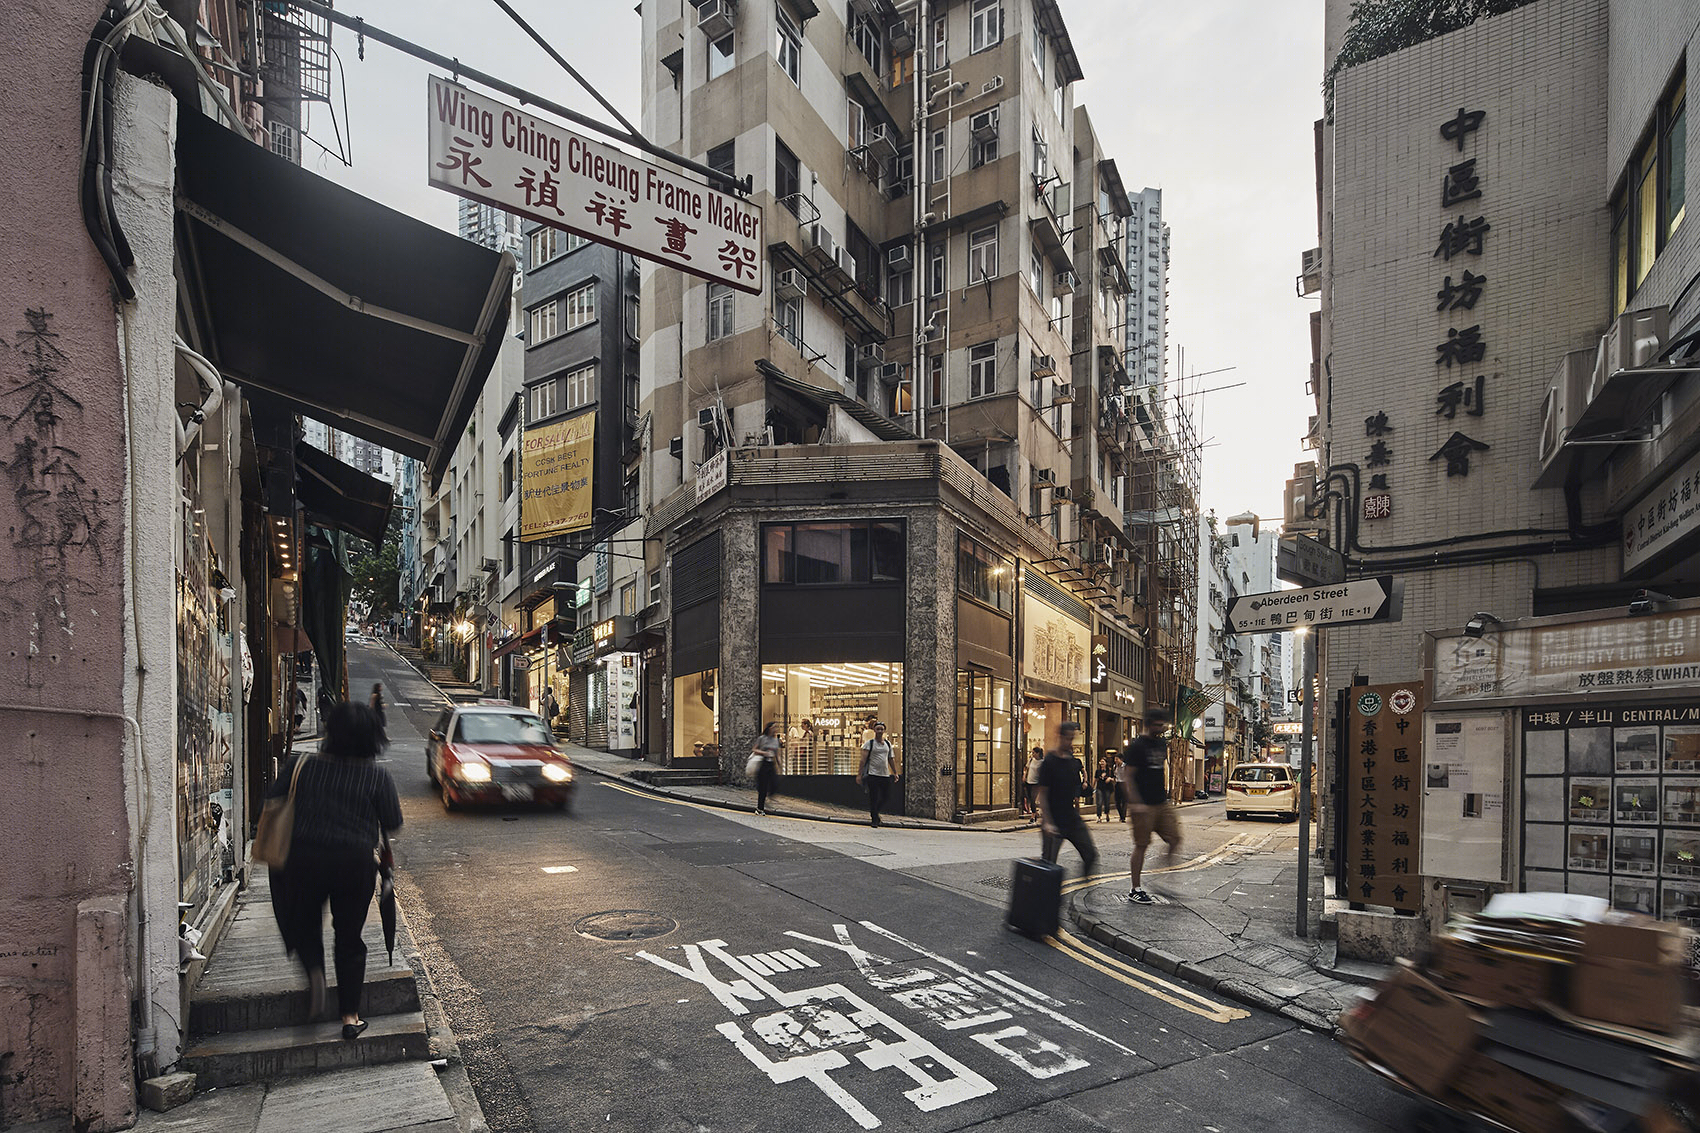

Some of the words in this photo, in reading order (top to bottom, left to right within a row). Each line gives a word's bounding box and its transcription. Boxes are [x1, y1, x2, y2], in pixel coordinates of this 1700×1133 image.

[435, 82, 494, 149] Wing
[501, 110, 560, 173] Ching
[567, 136, 639, 203] Cheung
[646, 167, 701, 219] Frame
[708, 191, 759, 240] Maker
[436, 136, 757, 280] 永禎祥畫架
[1429, 107, 1491, 478] 中區街坊福利會
[525, 437, 543, 451] FOR
[557, 450, 577, 461] BEST
[524, 465, 559, 479] FORTUNE
[560, 457, 591, 473] REALTY
[523, 522, 542, 531] TEL:
[1317, 547, 1333, 563] Street
[1261, 593, 1309, 607] Aberdeen
[1313, 587, 1349, 599] Street
[1270, 607, 1333, 625] 鴨巴甸街
[1541, 648, 1615, 669] PROPERTY
[1529, 712, 1561, 726] 中環
[1578, 709, 1613, 724] 半山
[1359, 719, 1378, 899] 香港中區大廈業主聯會
[1391, 718, 1411, 902] 中區街坊福利會
